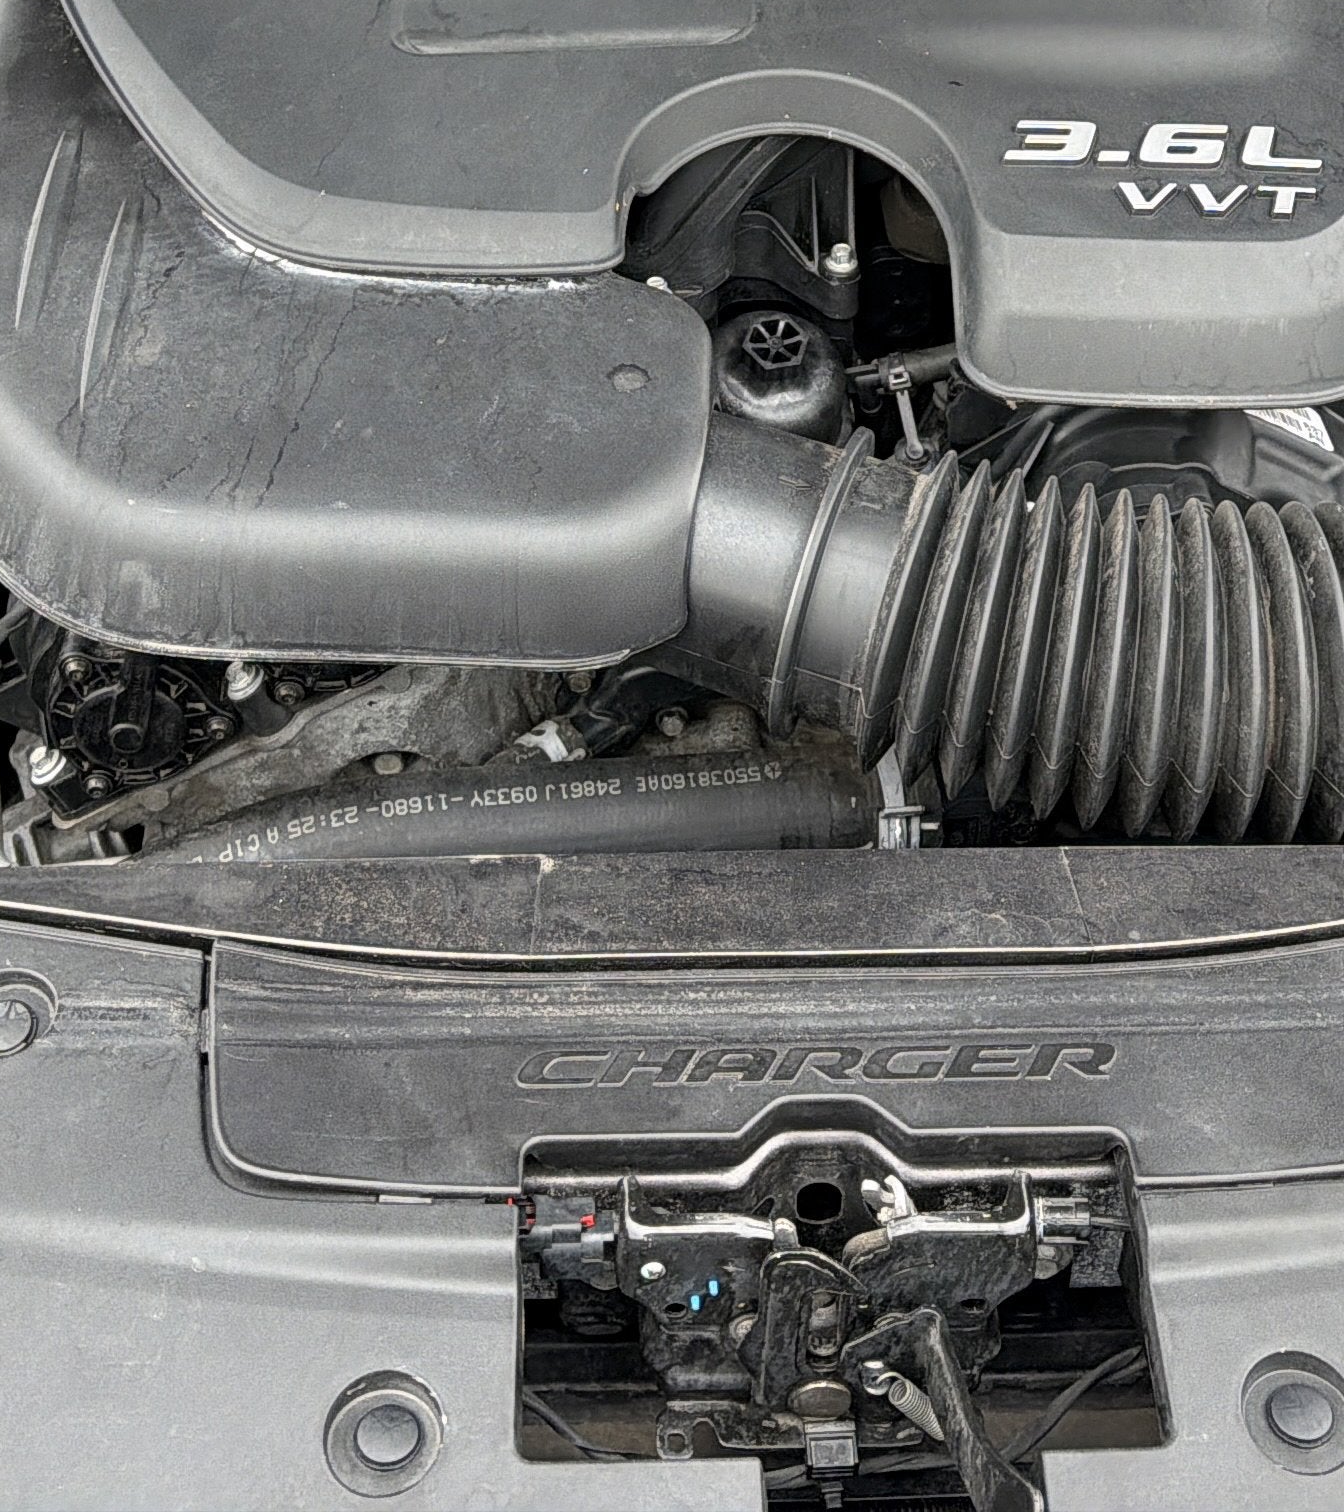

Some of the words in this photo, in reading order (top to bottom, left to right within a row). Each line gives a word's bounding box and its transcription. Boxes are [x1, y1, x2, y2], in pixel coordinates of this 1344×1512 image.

[1002, 120, 1323, 174] 3.6L
[1113, 182, 1317, 220] VVT
[545, 778, 622, 801] 24861J
[635, 766, 762, 793] 55038160AE
[516, 1042, 1117, 1088] CHARGER
